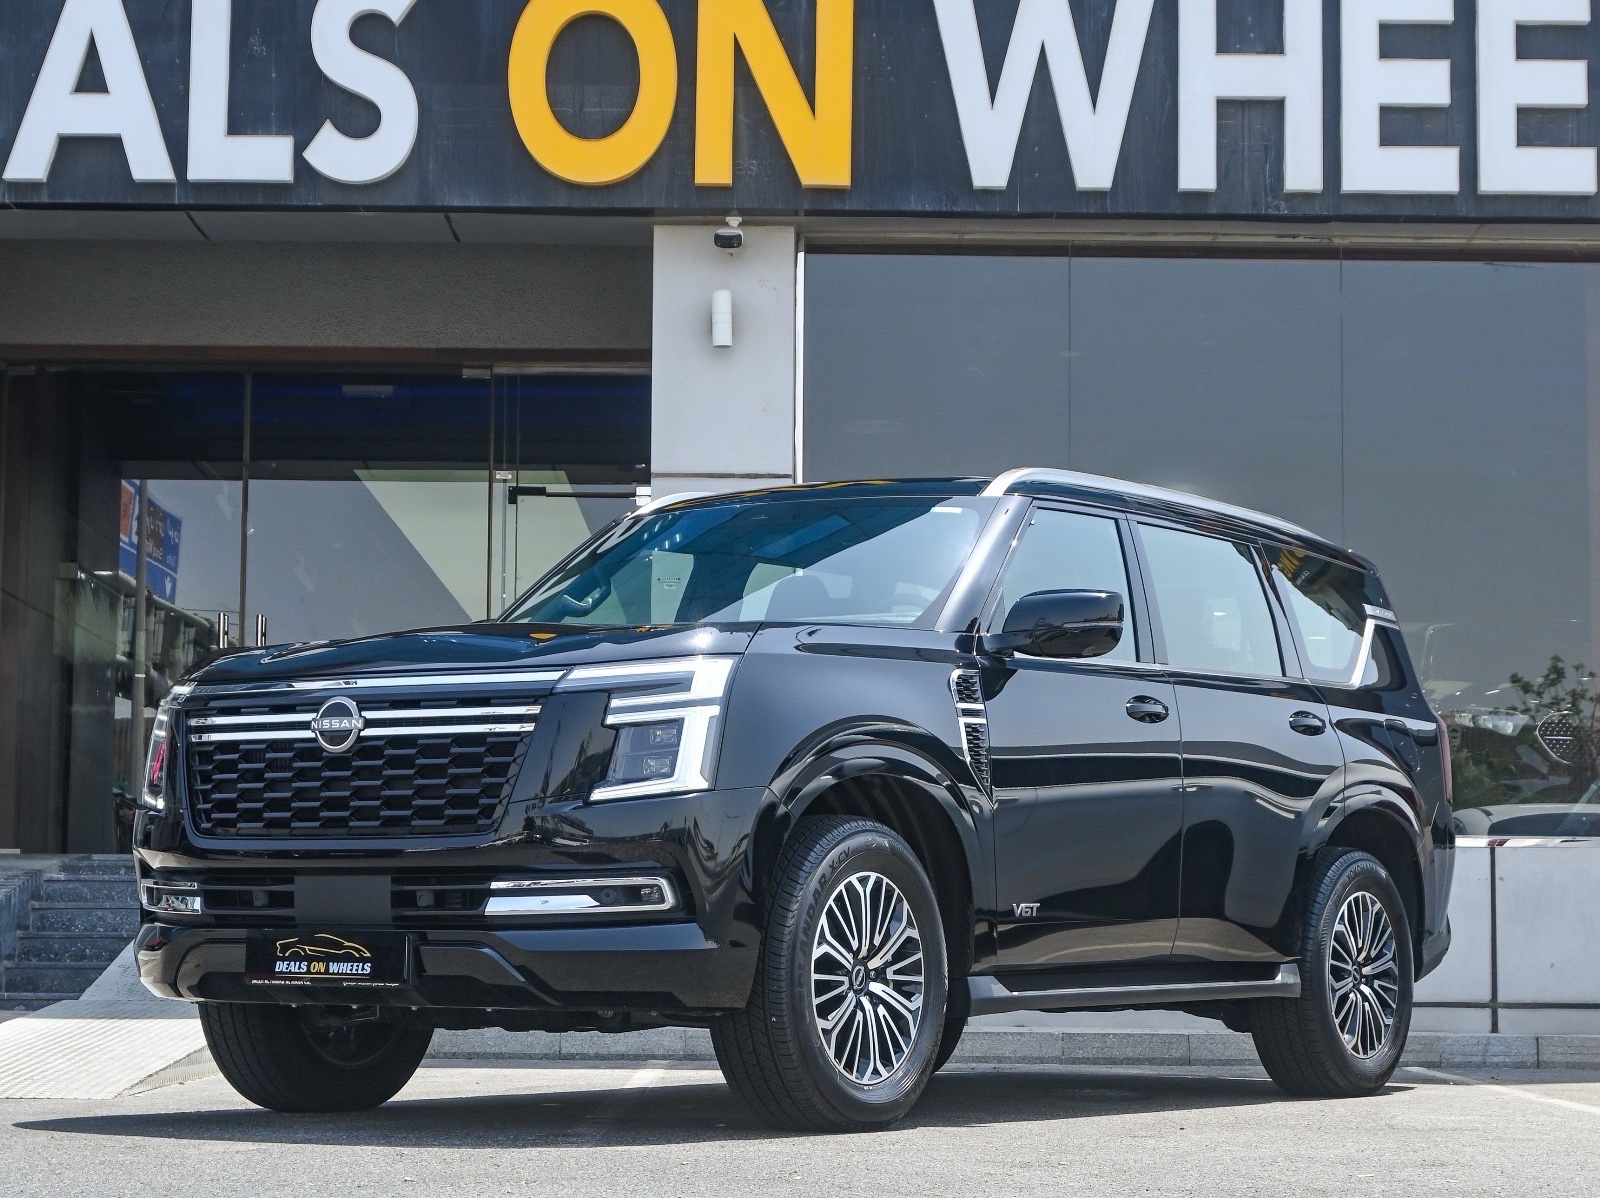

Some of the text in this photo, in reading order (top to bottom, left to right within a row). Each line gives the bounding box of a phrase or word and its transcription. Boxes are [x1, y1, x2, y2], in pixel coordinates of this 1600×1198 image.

[2, 0, 1598, 195] ALS ON WHEE
[311, 719, 361, 729] NISSAN
[1012, 902, 1041, 917] V6T
[274, 961, 372, 974] DEALS ON WHEELS
